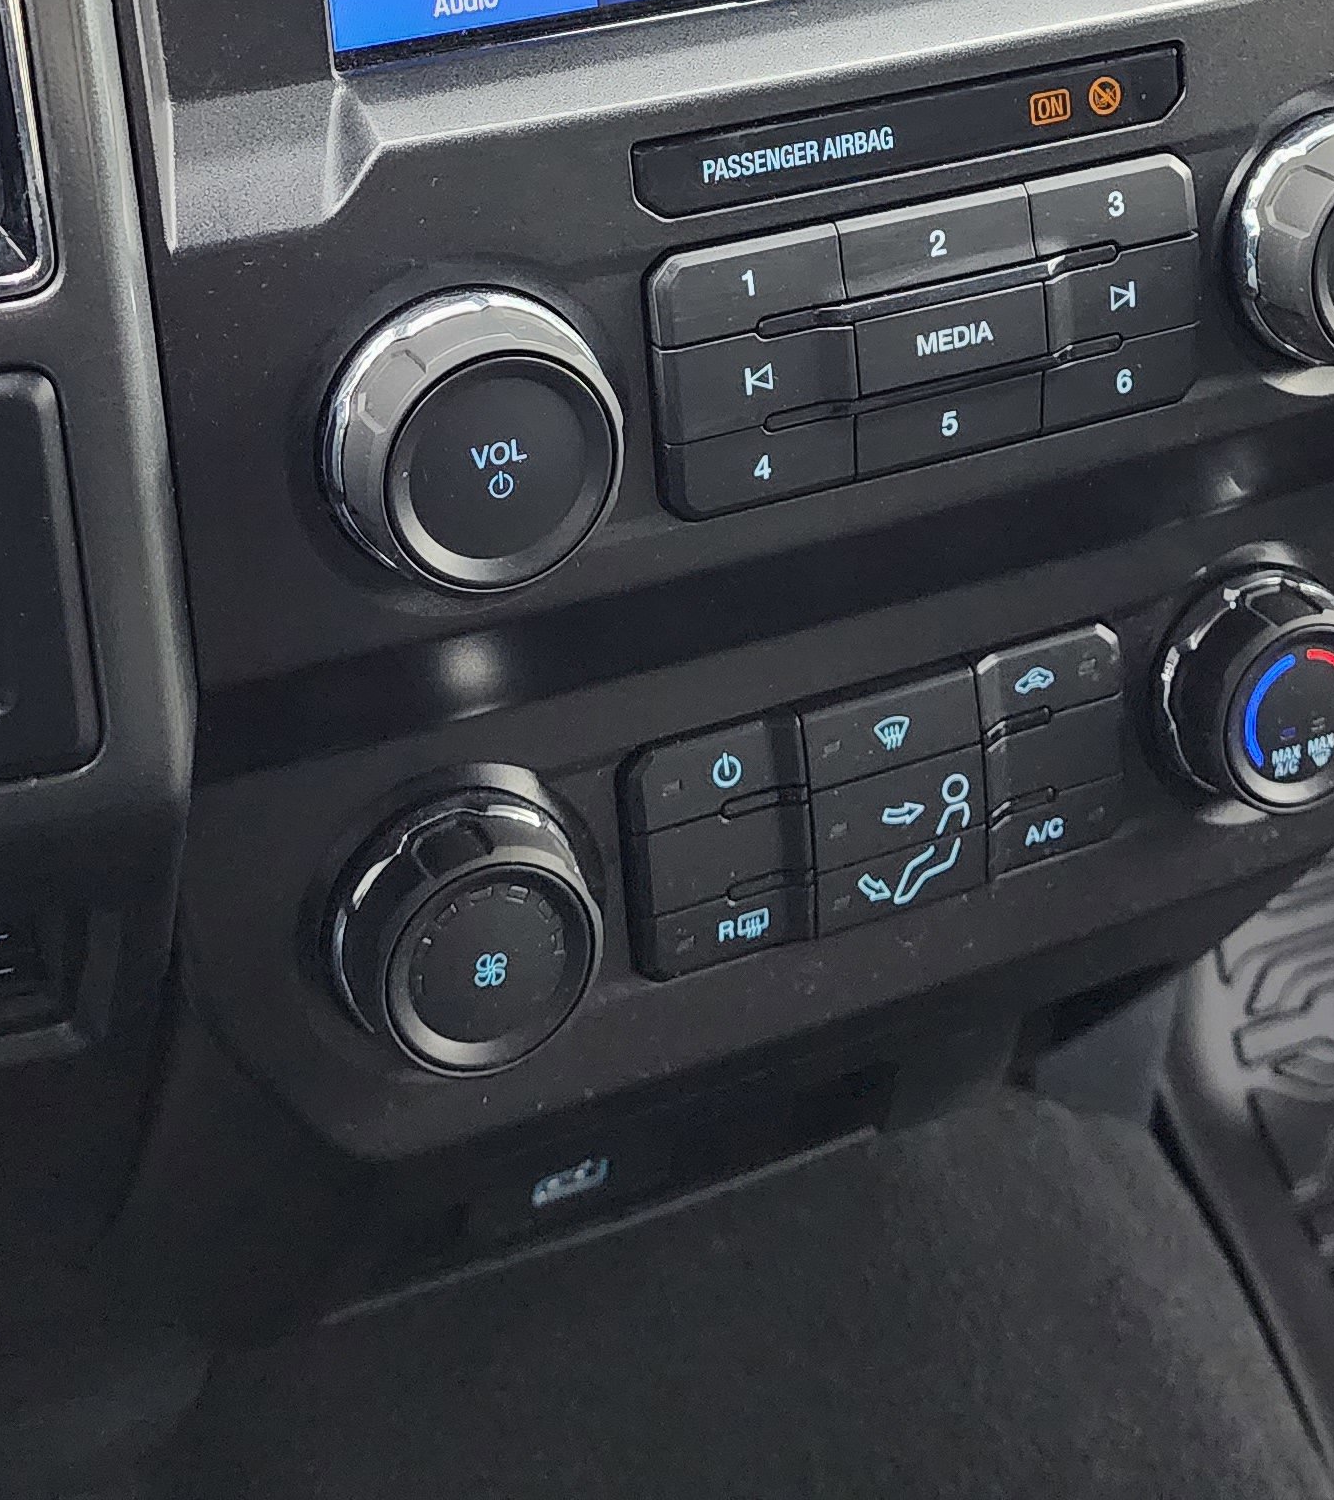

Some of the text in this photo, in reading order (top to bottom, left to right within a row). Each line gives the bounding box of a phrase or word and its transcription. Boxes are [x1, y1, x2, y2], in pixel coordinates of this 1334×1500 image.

[1037, 96, 1064, 119] ON
[702, 126, 895, 183] PASSENGER AIRBAG
[1107, 190, 1126, 217] 3
[929, 230, 948, 257] 2
[741, 269, 756, 296] 1
[916, 321, 994, 357] MEDIA
[1115, 368, 1133, 394] 6
[941, 410, 960, 436] 5
[470, 439, 528, 470] VOL
[753, 455, 772, 479] 4
[1272, 744, 1302, 766] MAX
[1025, 817, 1064, 846] A/C
[718, 920, 734, 942] R
